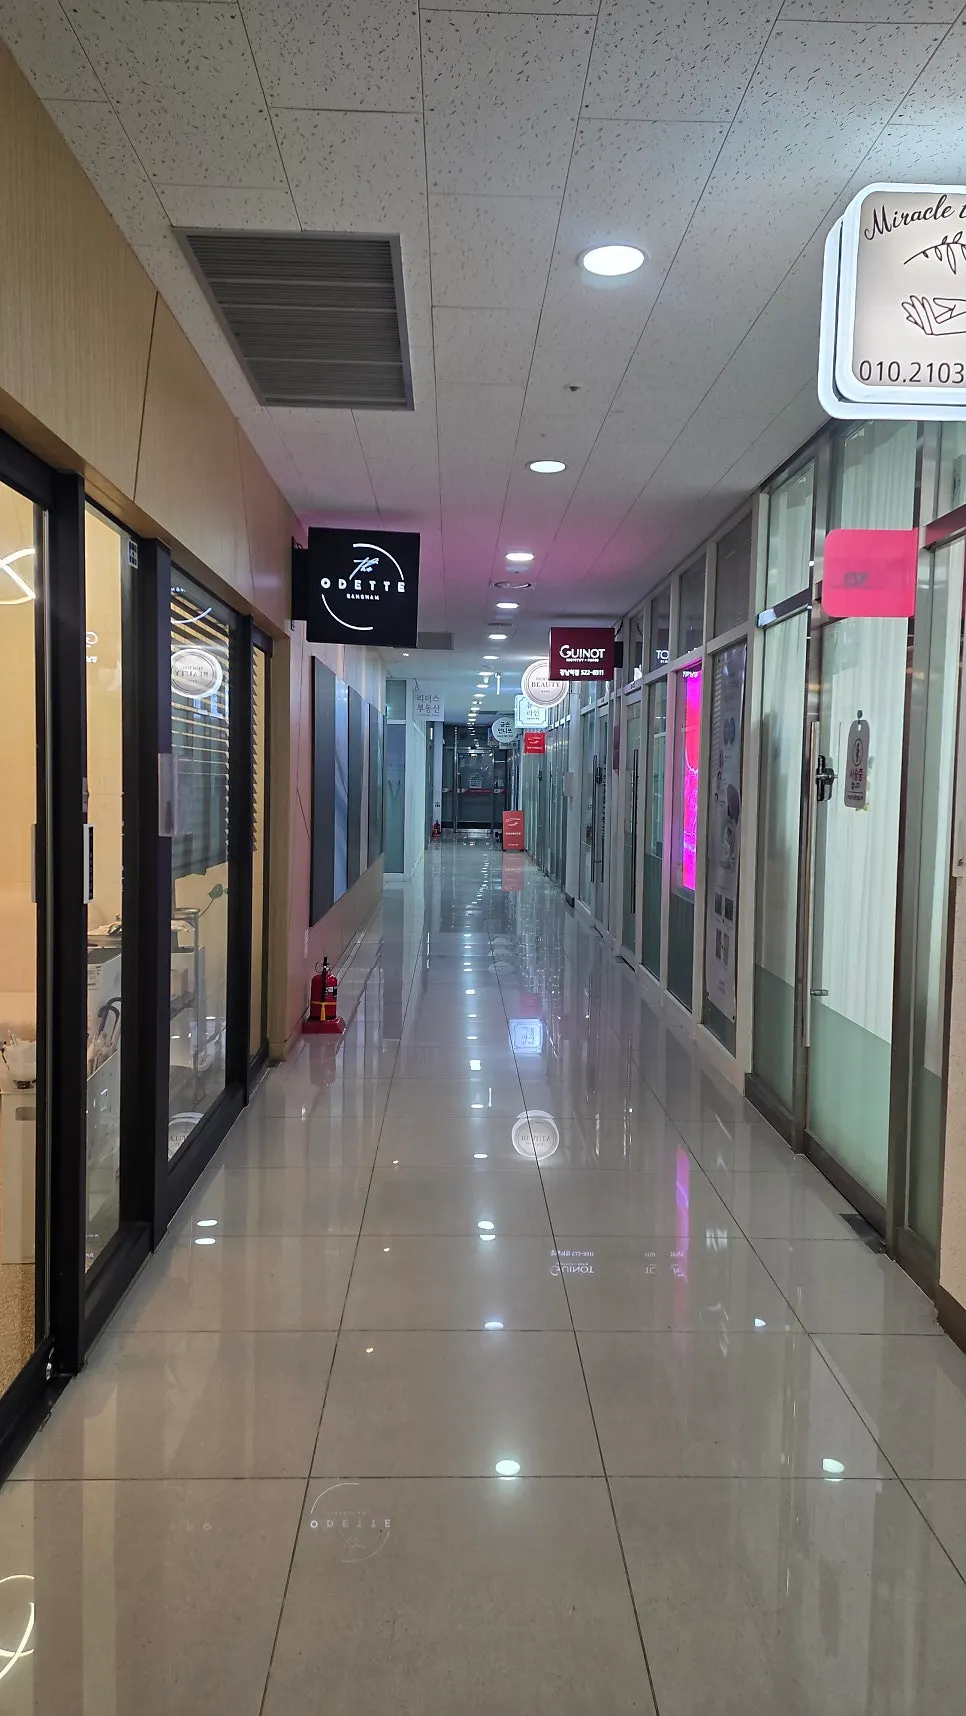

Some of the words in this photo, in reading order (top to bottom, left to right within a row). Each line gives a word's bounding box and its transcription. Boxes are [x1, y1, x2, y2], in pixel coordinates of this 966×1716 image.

[864, 194, 955, 241] Miracle
[859, 360, 965, 385] 010.2103
[320, 577, 406, 593] ODETTE
[346, 593, 380, 601] GANGNAM
[559, 645, 606, 660] GUINOT
[416, 704, 441, 714] 부동산
